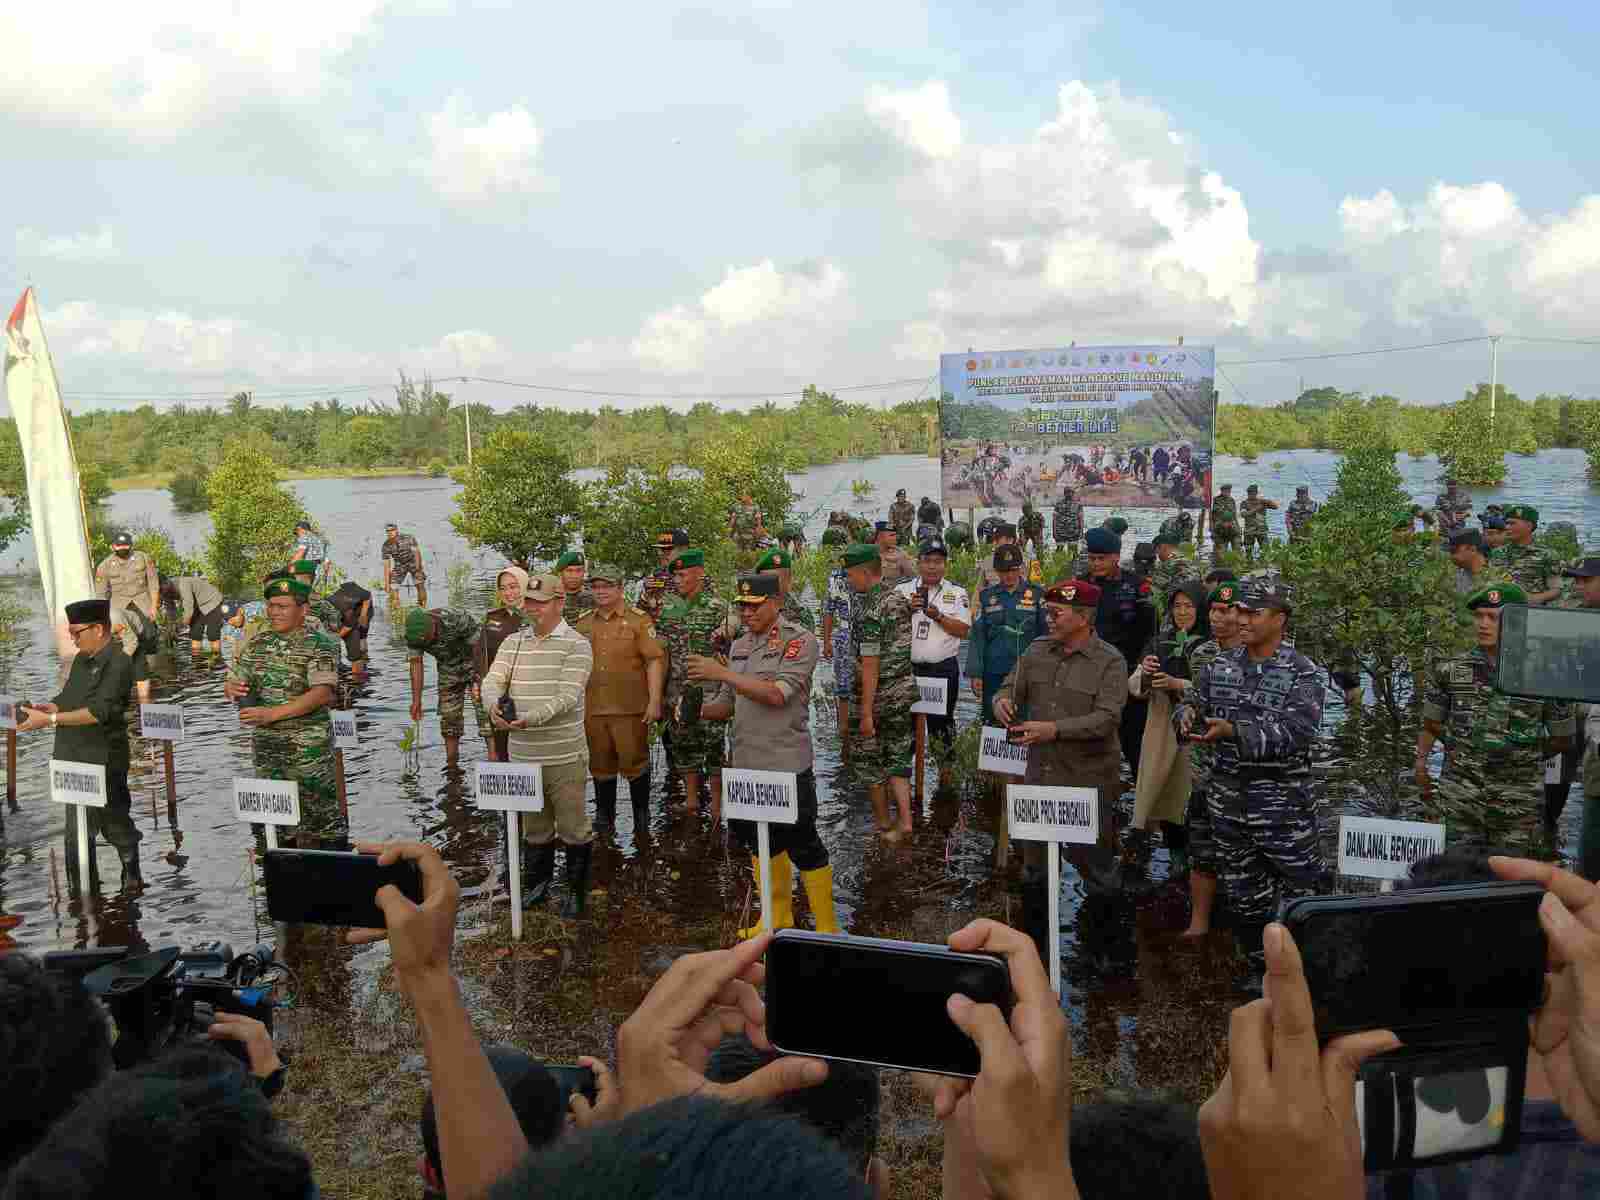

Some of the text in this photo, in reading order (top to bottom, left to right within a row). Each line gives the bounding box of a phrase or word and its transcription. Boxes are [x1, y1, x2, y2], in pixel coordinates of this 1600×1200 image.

[479, 774, 536, 797] GUBERNUR BENGKULU
[727, 780, 790, 808] KAPOLDA BENGKULU
[1014, 798, 1040, 823] KABINDA
[1057, 800, 1091, 827] BENGKULU
[1345, 831, 1388, 861] DANLANAL
